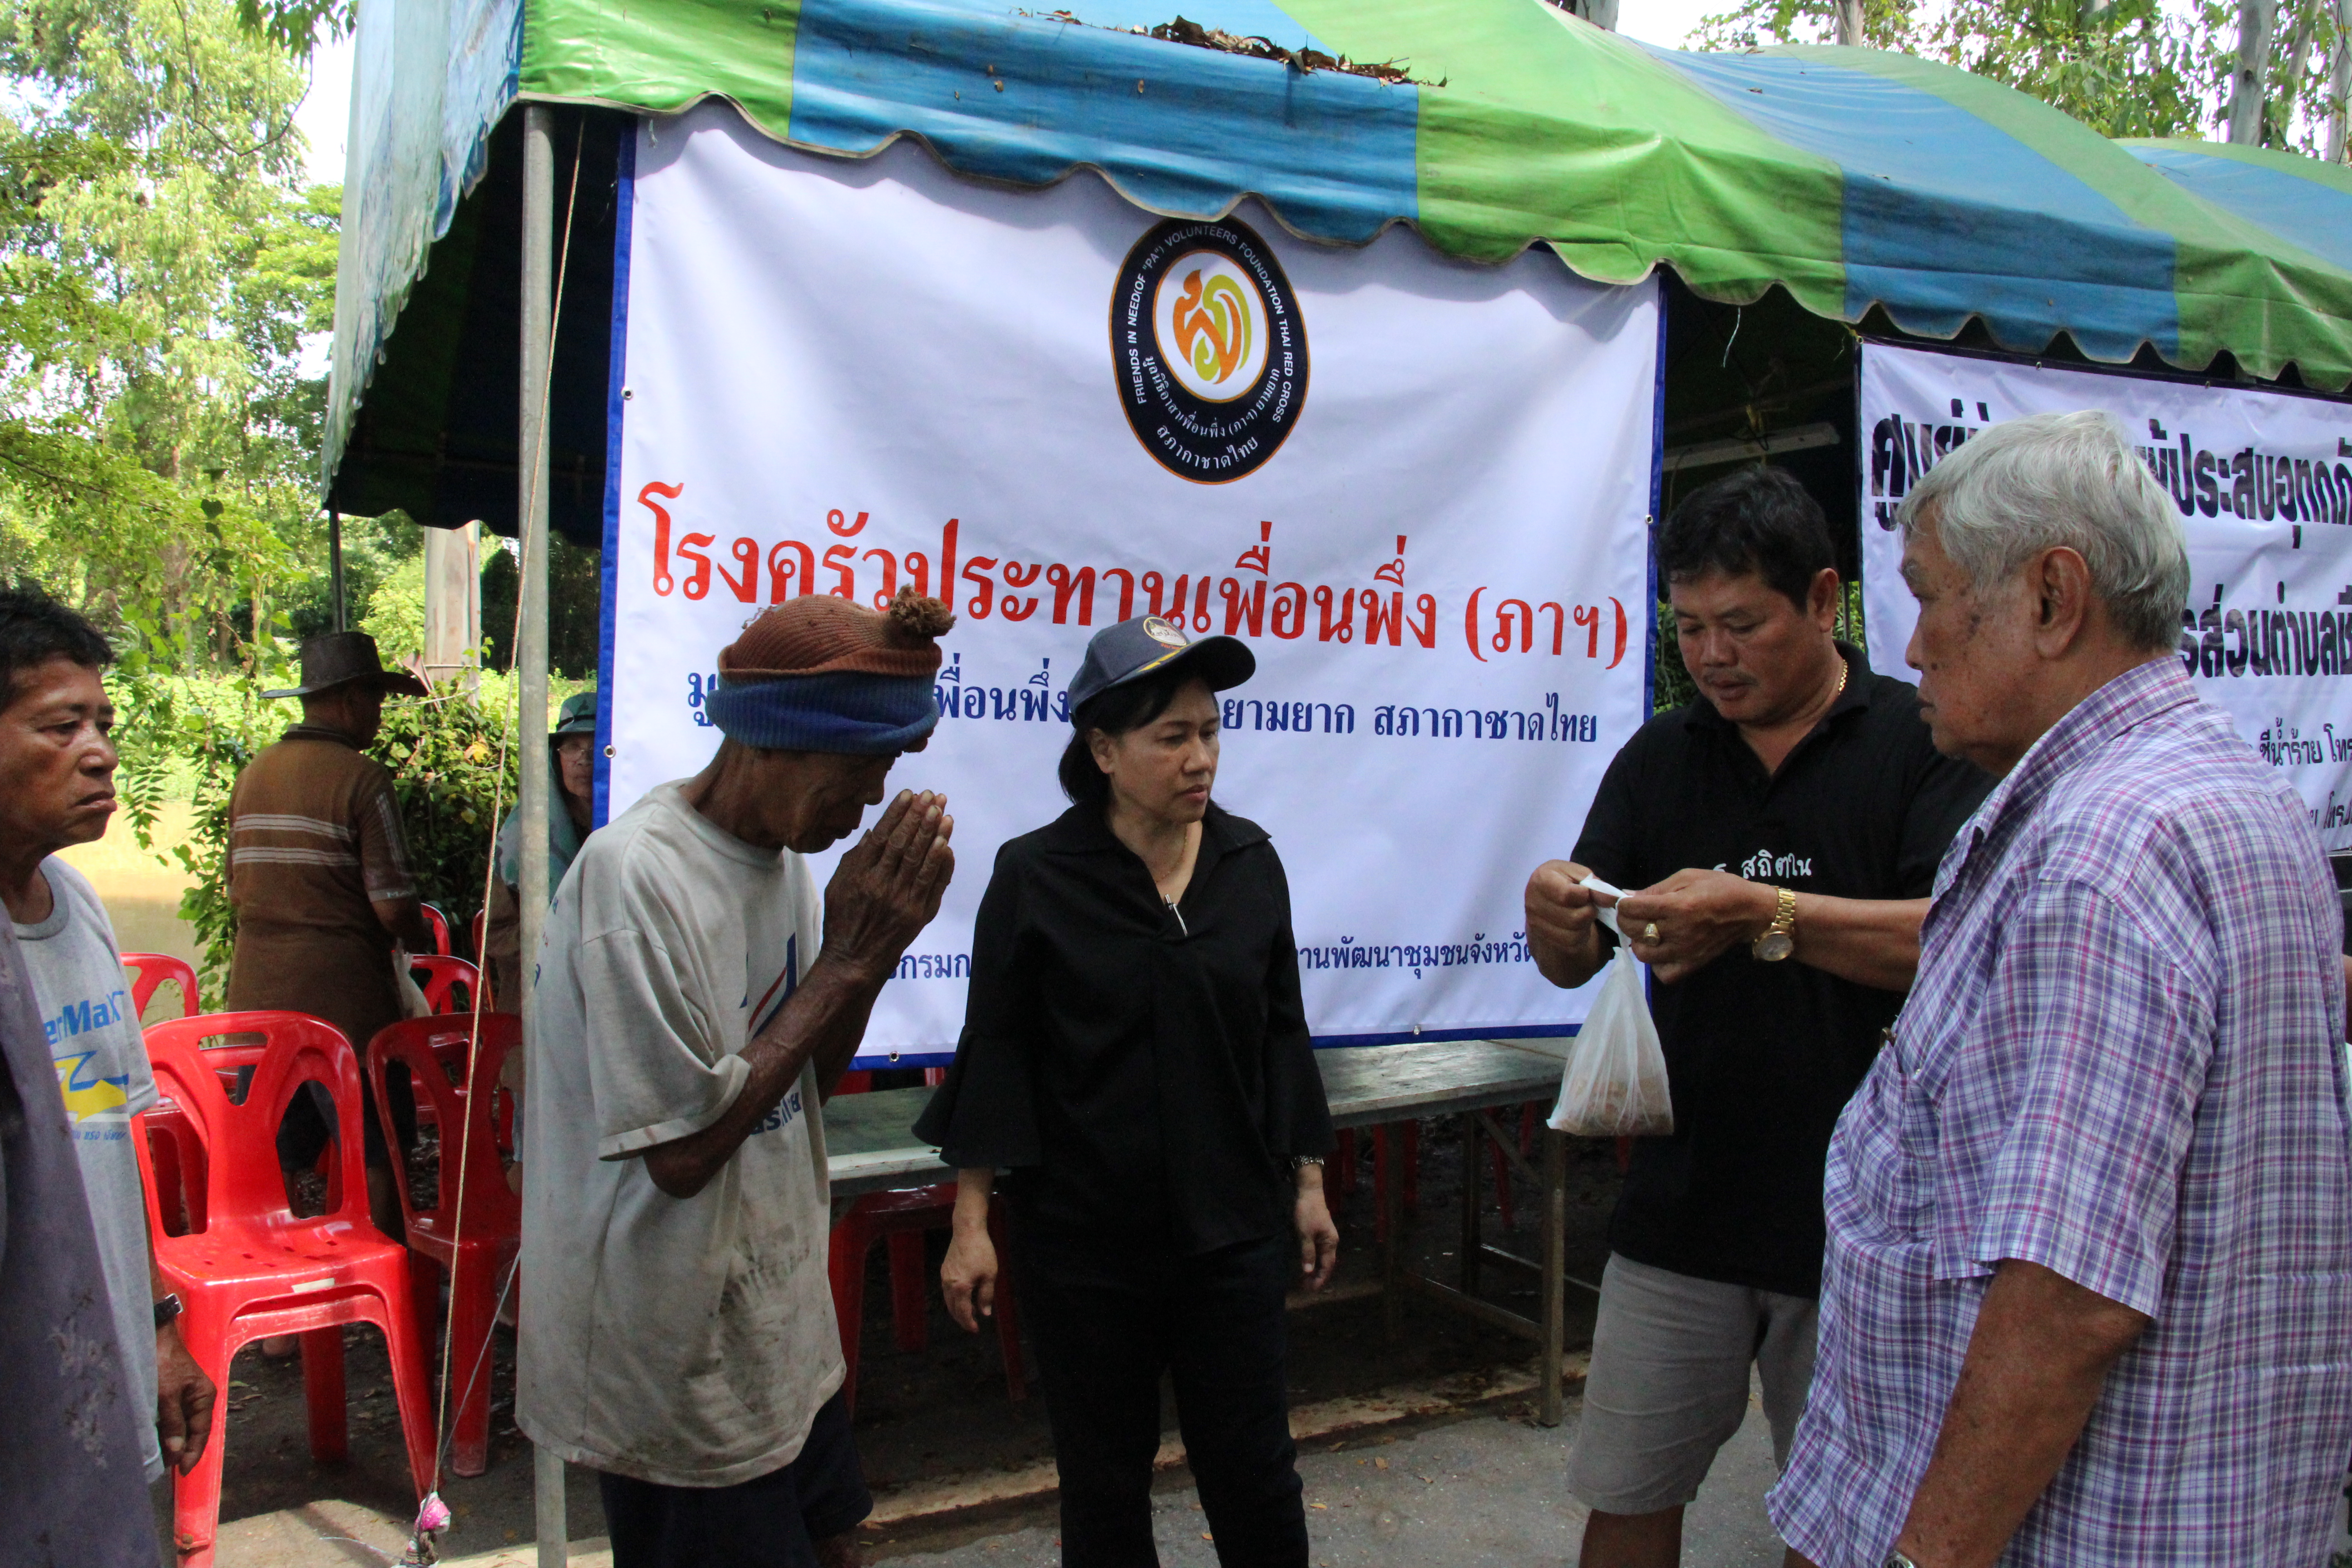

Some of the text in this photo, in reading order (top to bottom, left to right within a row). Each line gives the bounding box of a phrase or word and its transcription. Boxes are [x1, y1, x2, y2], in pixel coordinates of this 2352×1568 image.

[1164, 225, 1238, 246] VOLUNTEERS
[1239, 242, 1284, 314] FOUNDATION
[1128, 330, 1137, 343] IN
[1279, 318, 1292, 347] THAI
[1128, 348, 1147, 404] FRIENDS
[1284, 352, 1294, 377] RED
[1256, 368, 1280, 410] ยามยาก
[1272, 381, 1292, 423] CROSS
[1157, 425, 1258, 469] สภากาชาดไทย
[1465, 586, 1628, 670] (ภาฯ)
[1222, 696, 1355, 734] ยามยาก
[1374, 692, 1598, 743] สภากาชาดไทย
